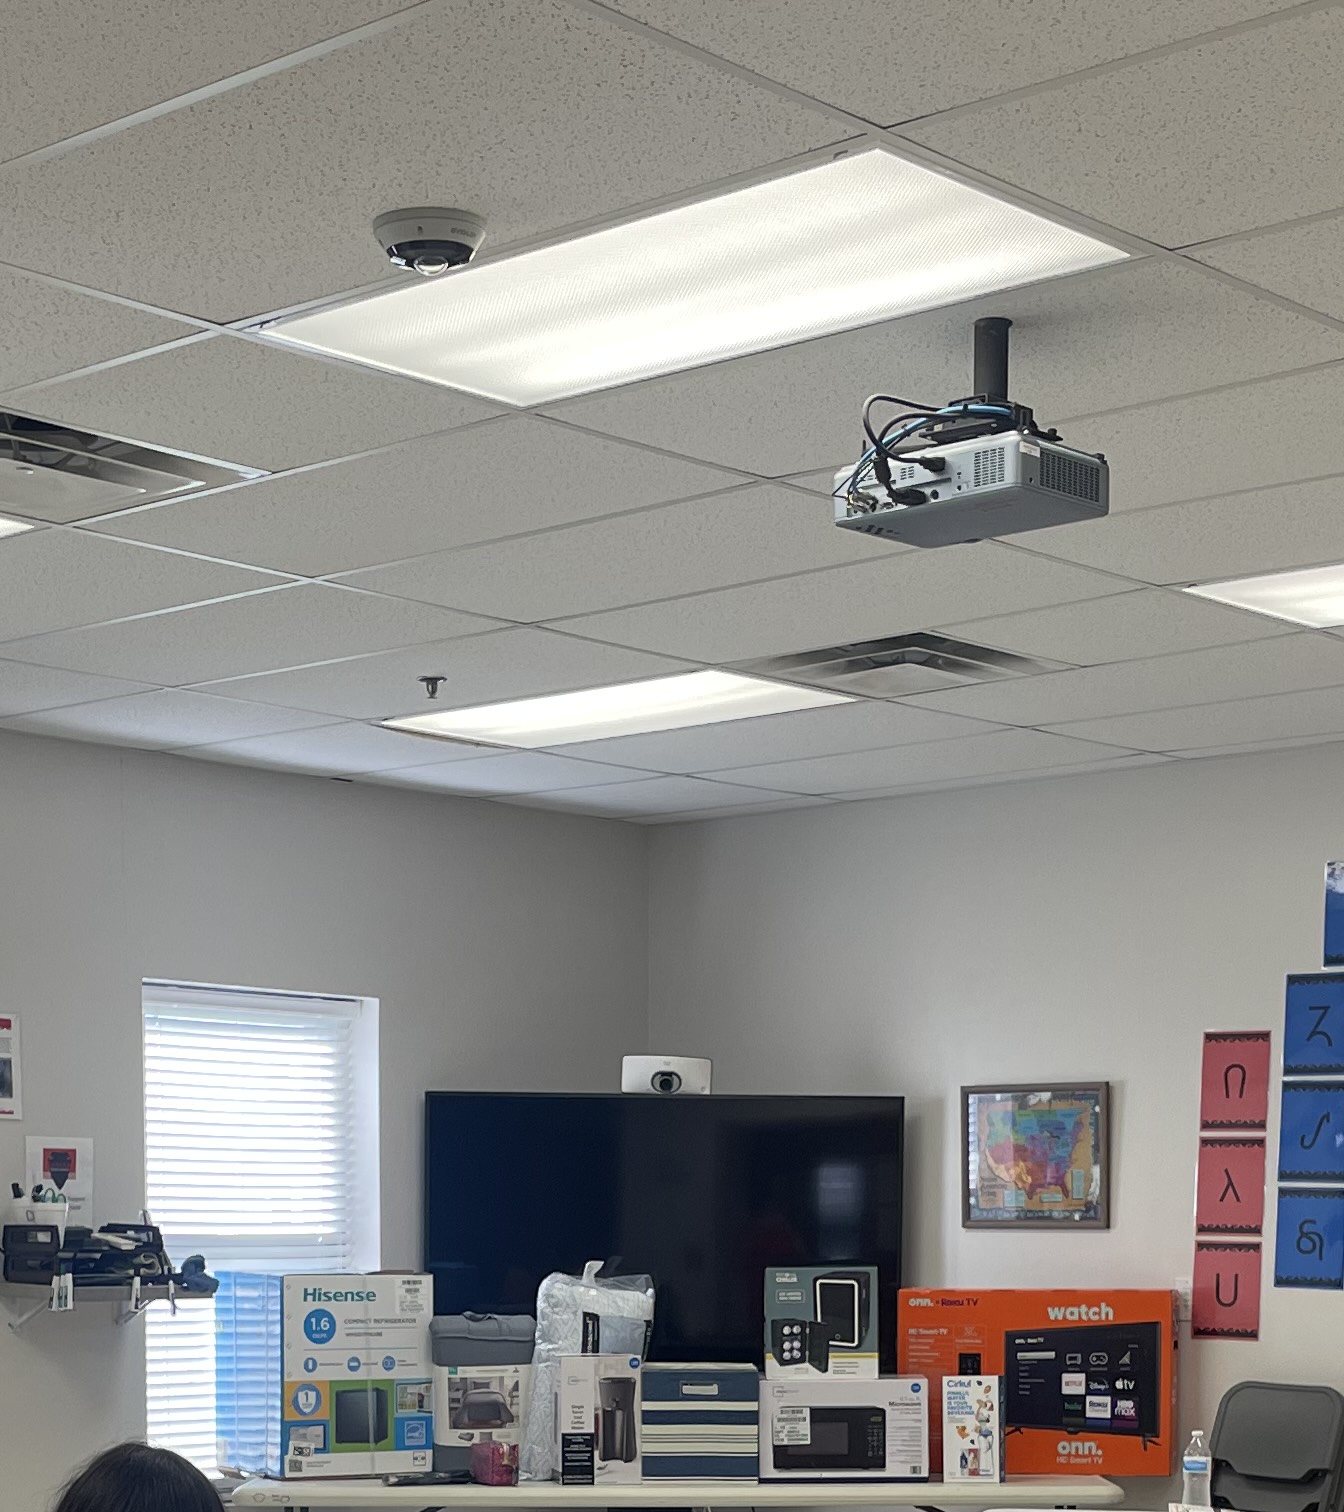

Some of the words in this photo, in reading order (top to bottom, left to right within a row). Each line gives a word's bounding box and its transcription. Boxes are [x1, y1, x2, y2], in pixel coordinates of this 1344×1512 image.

[303, 1288, 376, 1302] Hisense
[908, 1298, 934, 1306] onn.
[966, 1298, 979, 1306] TV
[1047, 1302, 1114, 1321] watch
[310, 1318, 330, 1331] 1.6
[1114, 1406, 1136, 1417] max
[1057, 1440, 1103, 1456] onn.
